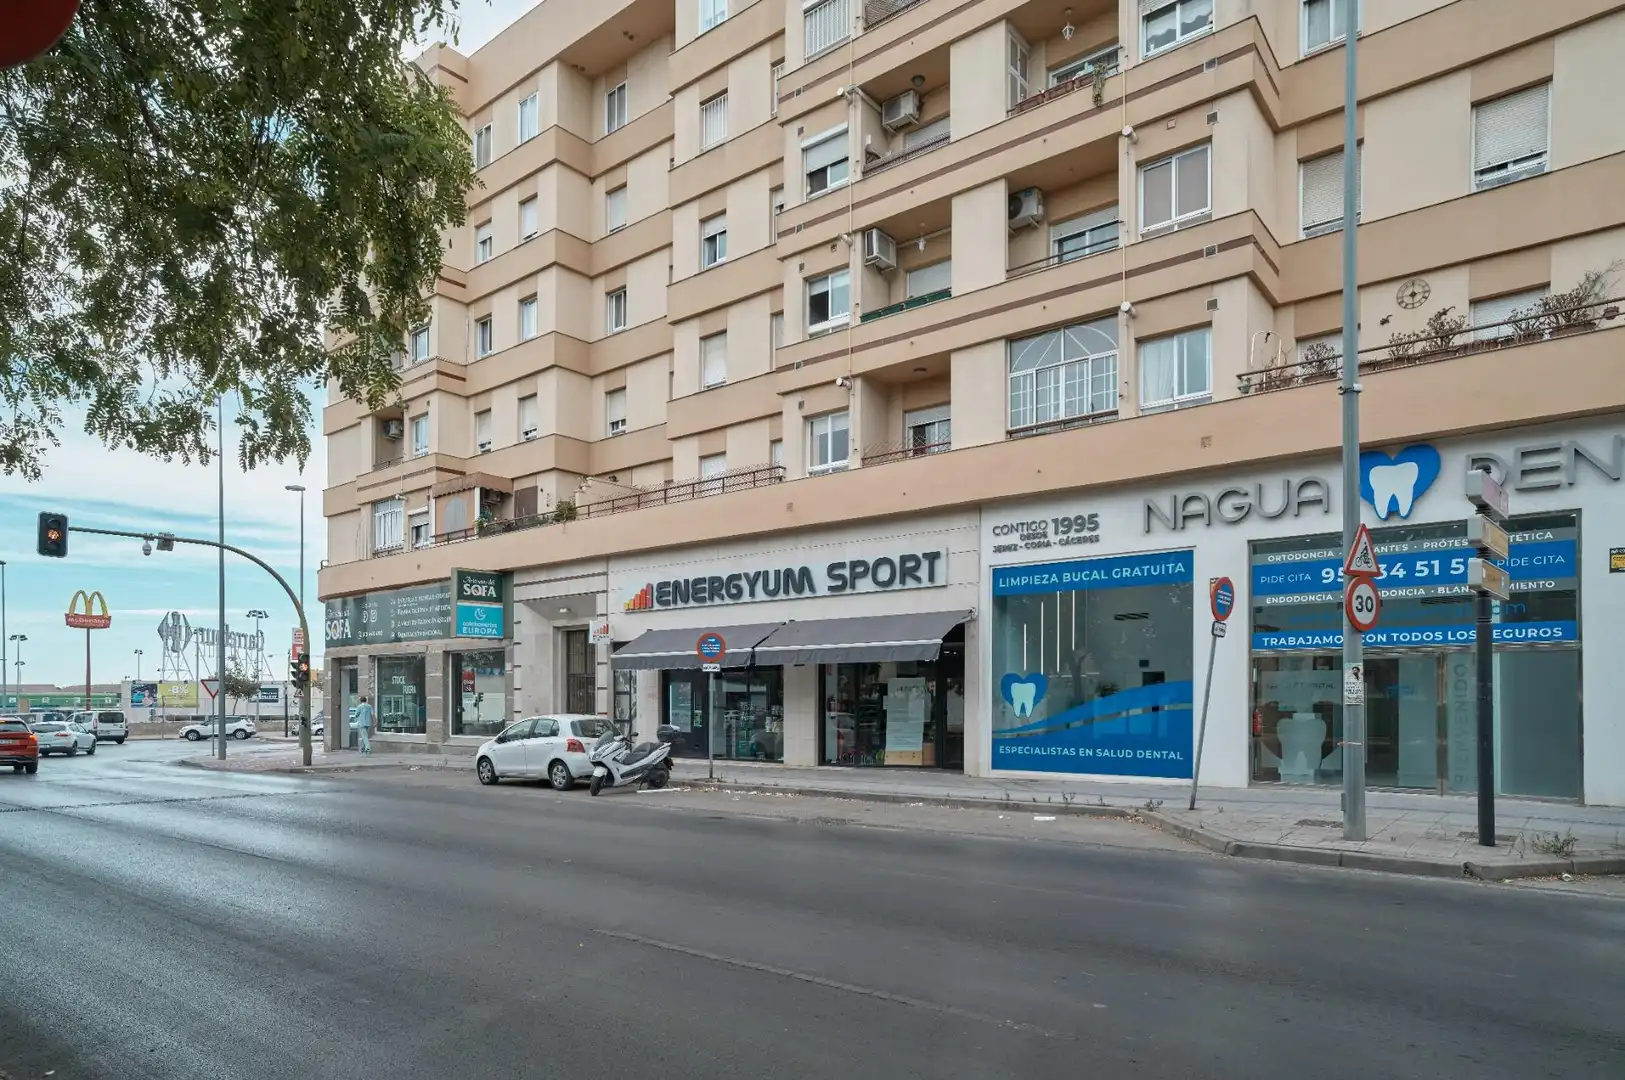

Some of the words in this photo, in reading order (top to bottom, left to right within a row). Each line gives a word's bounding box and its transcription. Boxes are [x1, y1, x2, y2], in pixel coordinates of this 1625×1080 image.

[1144, 475, 1329, 534] NAGUA
[992, 519, 1048, 536] CONTIGO
[1051, 512, 1100, 536] 1995
[1267, 550, 1335, 562] ORTODONCIA
[1374, 543, 1409, 553] ANTES
[1423, 538, 1469, 549] PRÓTES
[1509, 531, 1554, 542] TÉTICA
[655, 565, 816, 607] ENERGYUM
[826, 551, 942, 593] SPORT
[999, 573, 1059, 588] LIMPIEZA
[1062, 569, 1109, 583] BUCAL
[1111, 562, 1186, 579] GRATUITA
[1260, 574, 1285, 584] PIDE
[1287, 573, 1312, 583] CITA
[1414, 559, 1440, 577] 51
[1449, 558, 1468, 575] 5
[1497, 557, 1529, 568] PIDE
[1532, 554, 1565, 566] CITA
[463, 583, 497, 598] SOFA
[1266, 594, 1333, 604] ENDODONCIA
[1379, 588, 1426, 598] DONCIA
[1355, 595, 1374, 613] 30
[325, 618, 352, 641] SOFA
[462, 626, 498, 635] EUROPA
[1262, 635, 1344, 647] TRABAJAMO
[1361, 633, 1387, 643] ON
[1390, 631, 1443, 642] TODOS
[1447, 630, 1477, 641] LOS
[1492, 627, 1563, 639] EGUROS
[999, 745, 1076, 757] ESPECIALISTAS
[1078, 748, 1094, 757] EN
[1096, 748, 1134, 759] SALUD
[1136, 749, 1184, 760] DENTAL
